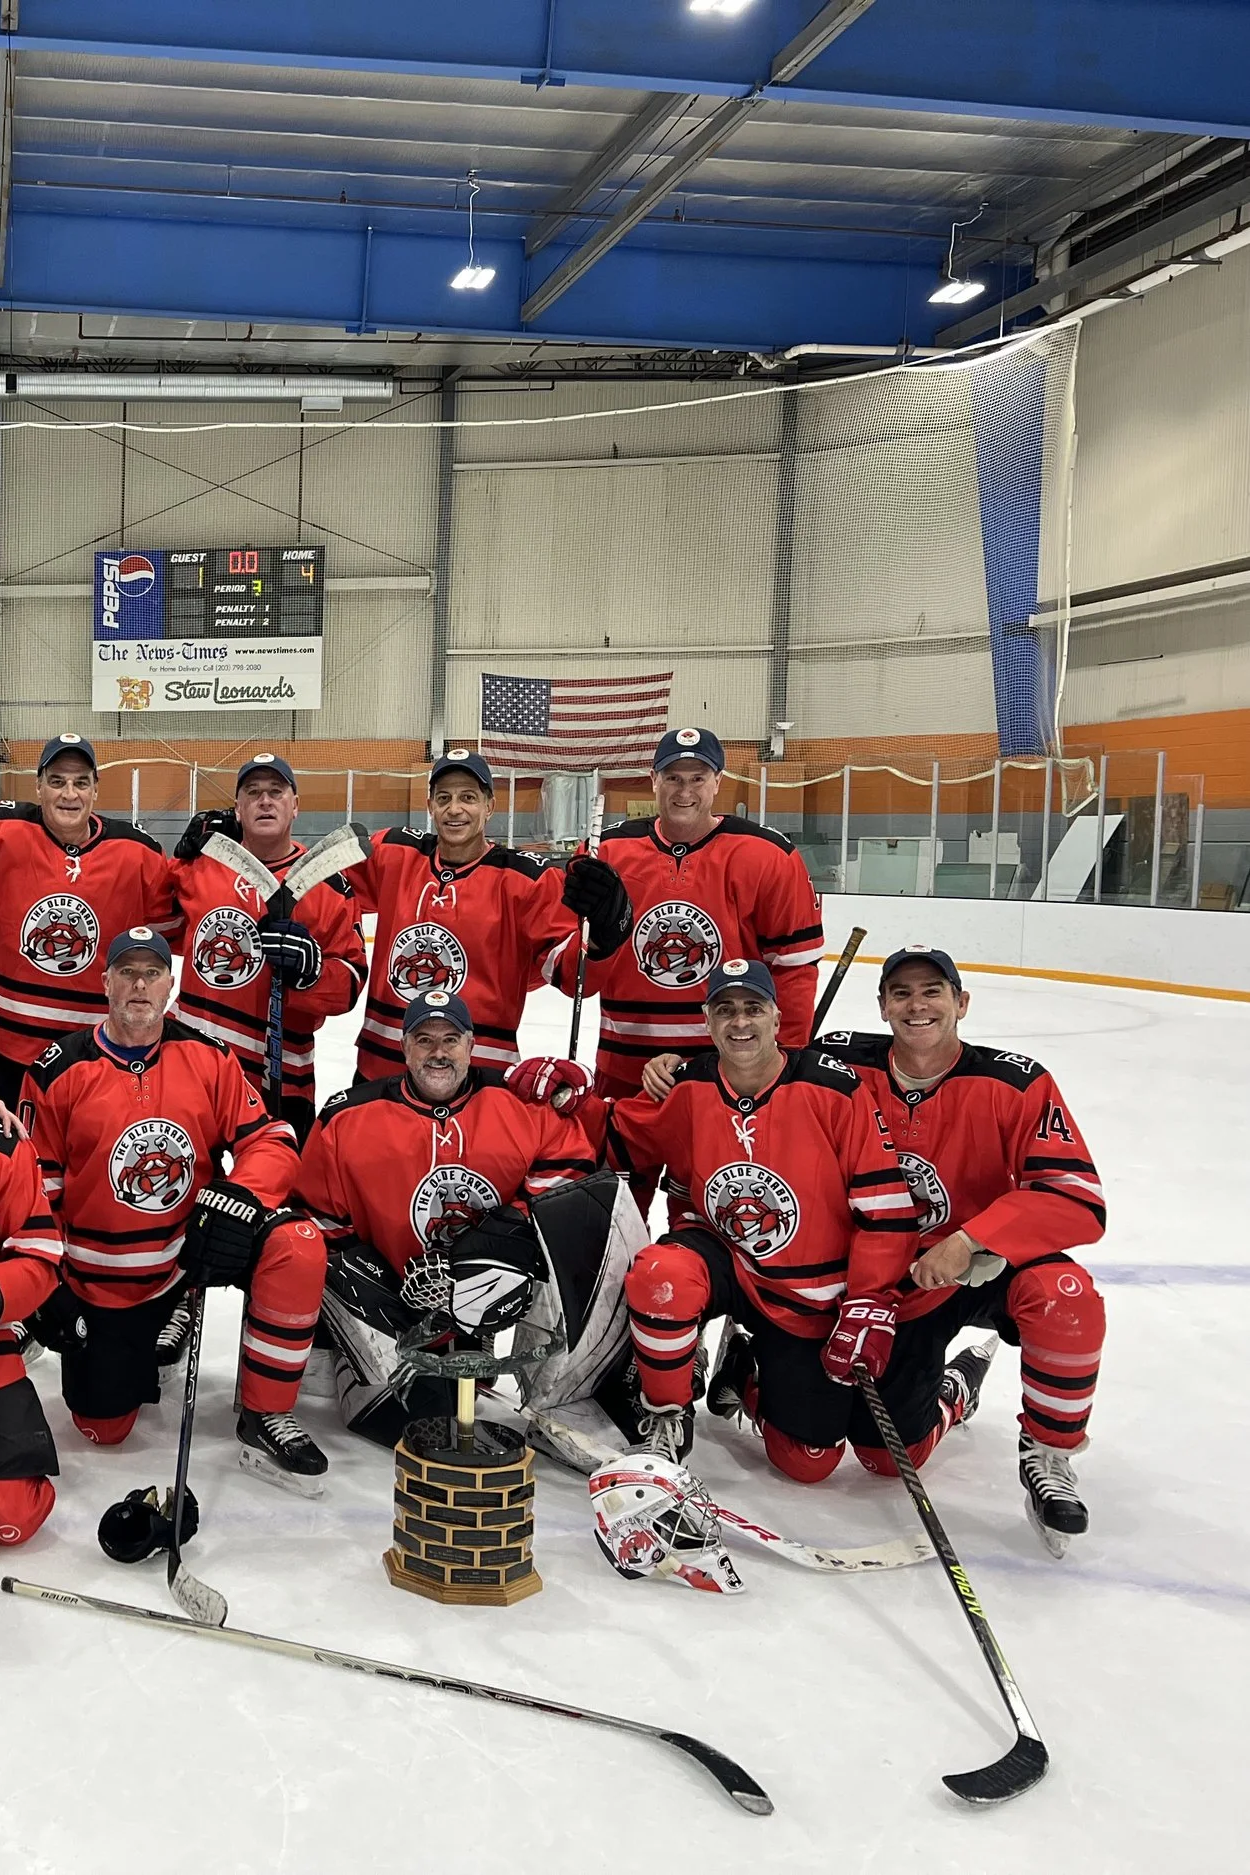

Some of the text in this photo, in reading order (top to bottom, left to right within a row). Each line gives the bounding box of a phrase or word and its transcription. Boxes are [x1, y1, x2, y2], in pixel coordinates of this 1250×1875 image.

[170, 550, 316, 563] GUEST HOME
[214, 584, 246, 593] PERIOD
[301, 563, 315, 584] 4
[102, 558, 120, 629] PEPSI
[215, 604, 270, 614] PENALTY 1
[214, 617, 270, 627] PENALTY 2
[98, 641, 229, 663] The News-Times
[234, 646, 315, 655] www.newstimes.com
[178, 665, 201, 673] Delivery
[203, 664, 214, 672] Call
[164, 675, 296, 704] Stew Leonard's
[30, 898, 95, 932] THE OLDE CRABS
[199, 910, 261, 951] THE OLDE CRABS
[639, 905, 714, 937] THE OLDE CRABS
[395, 932, 412, 949] THE
[439, 933, 462, 963] CRABS
[1035, 1099, 1076, 1145] 14
[114, 1141, 130, 1161] THE
[129, 1123, 155, 1141] OLDE
[417, 1170, 493, 1212] THE OLDE CRABS
[722, 1167, 752, 1181] OLDE
[757, 1170, 790, 1204] CRABS
[195, 1187, 258, 1224] ARRIOR
[845, 1306, 897, 1325] BAU
[717, 1552, 743, 1590] 3
[949, 1564, 987, 1620] ALPHA
